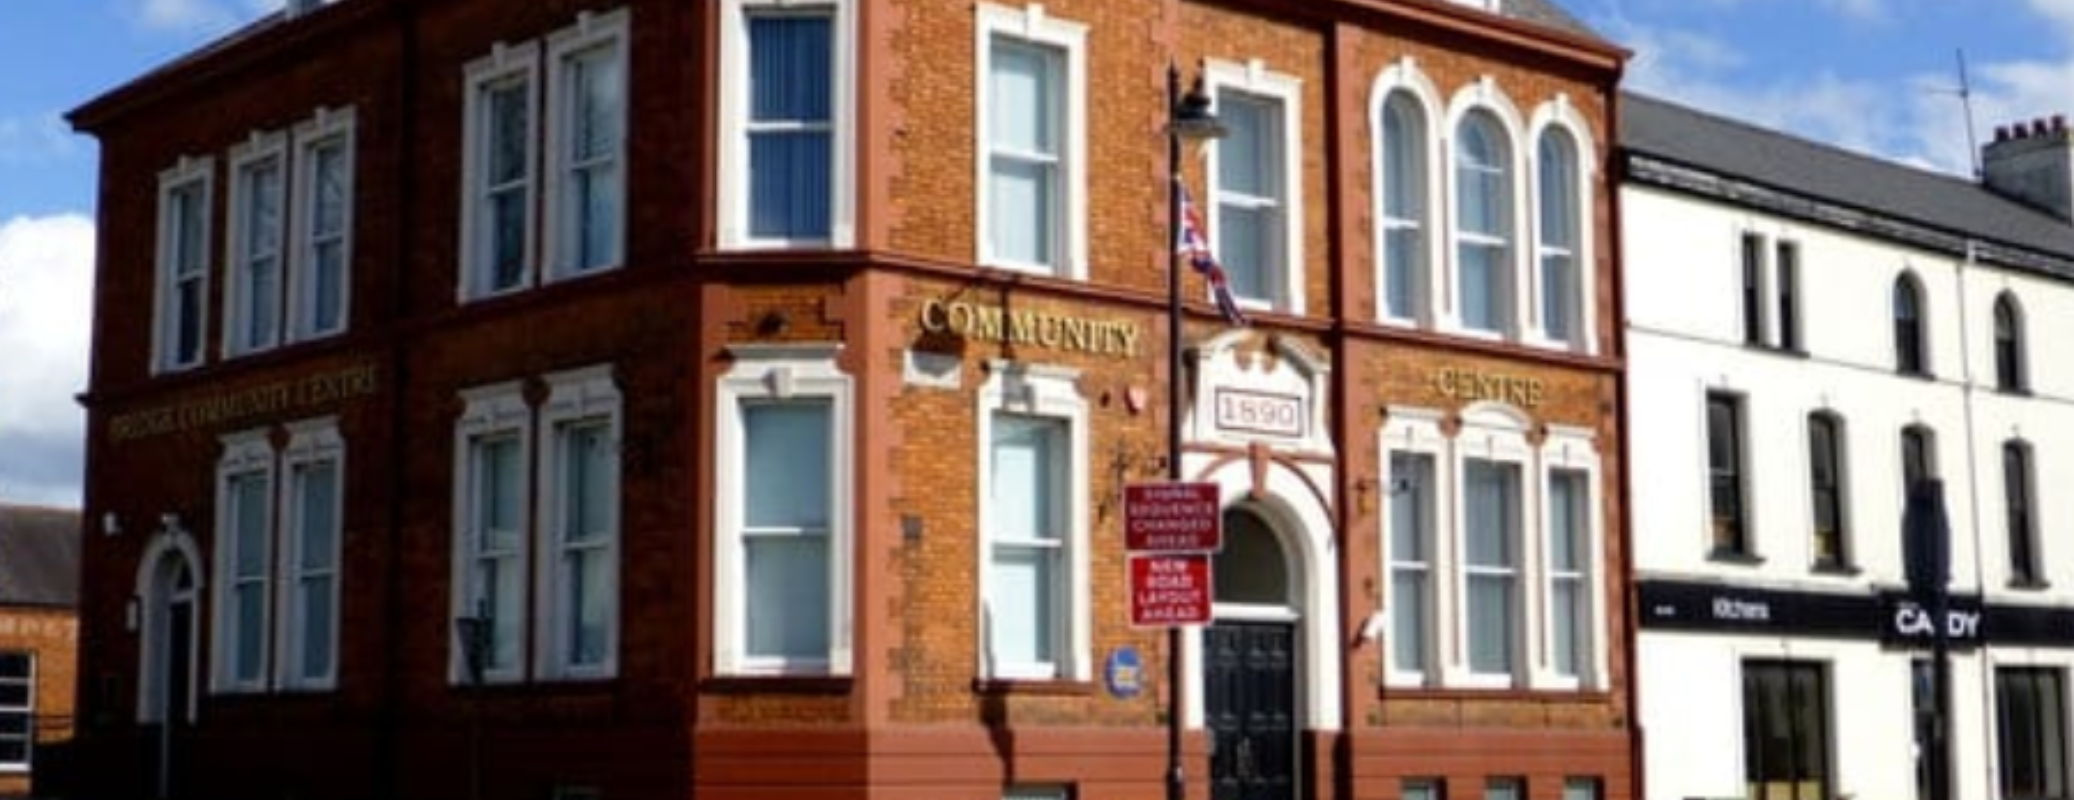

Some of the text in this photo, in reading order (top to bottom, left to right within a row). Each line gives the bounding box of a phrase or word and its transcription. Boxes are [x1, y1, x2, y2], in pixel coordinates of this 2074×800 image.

[922, 299, 1138, 357] COMMUNITY
[1438, 368, 1543, 405] CENTRE
[1222, 396, 1294, 428] 1890
[1131, 518, 1213, 532] CHANGED
[1150, 559, 1188, 573] NEW
[1146, 574, 1194, 588] ROAD
[1137, 590, 1202, 604] LAYOUT
[1141, 605, 1199, 620] AHEAD
[1895, 608, 1981, 637] CADY
